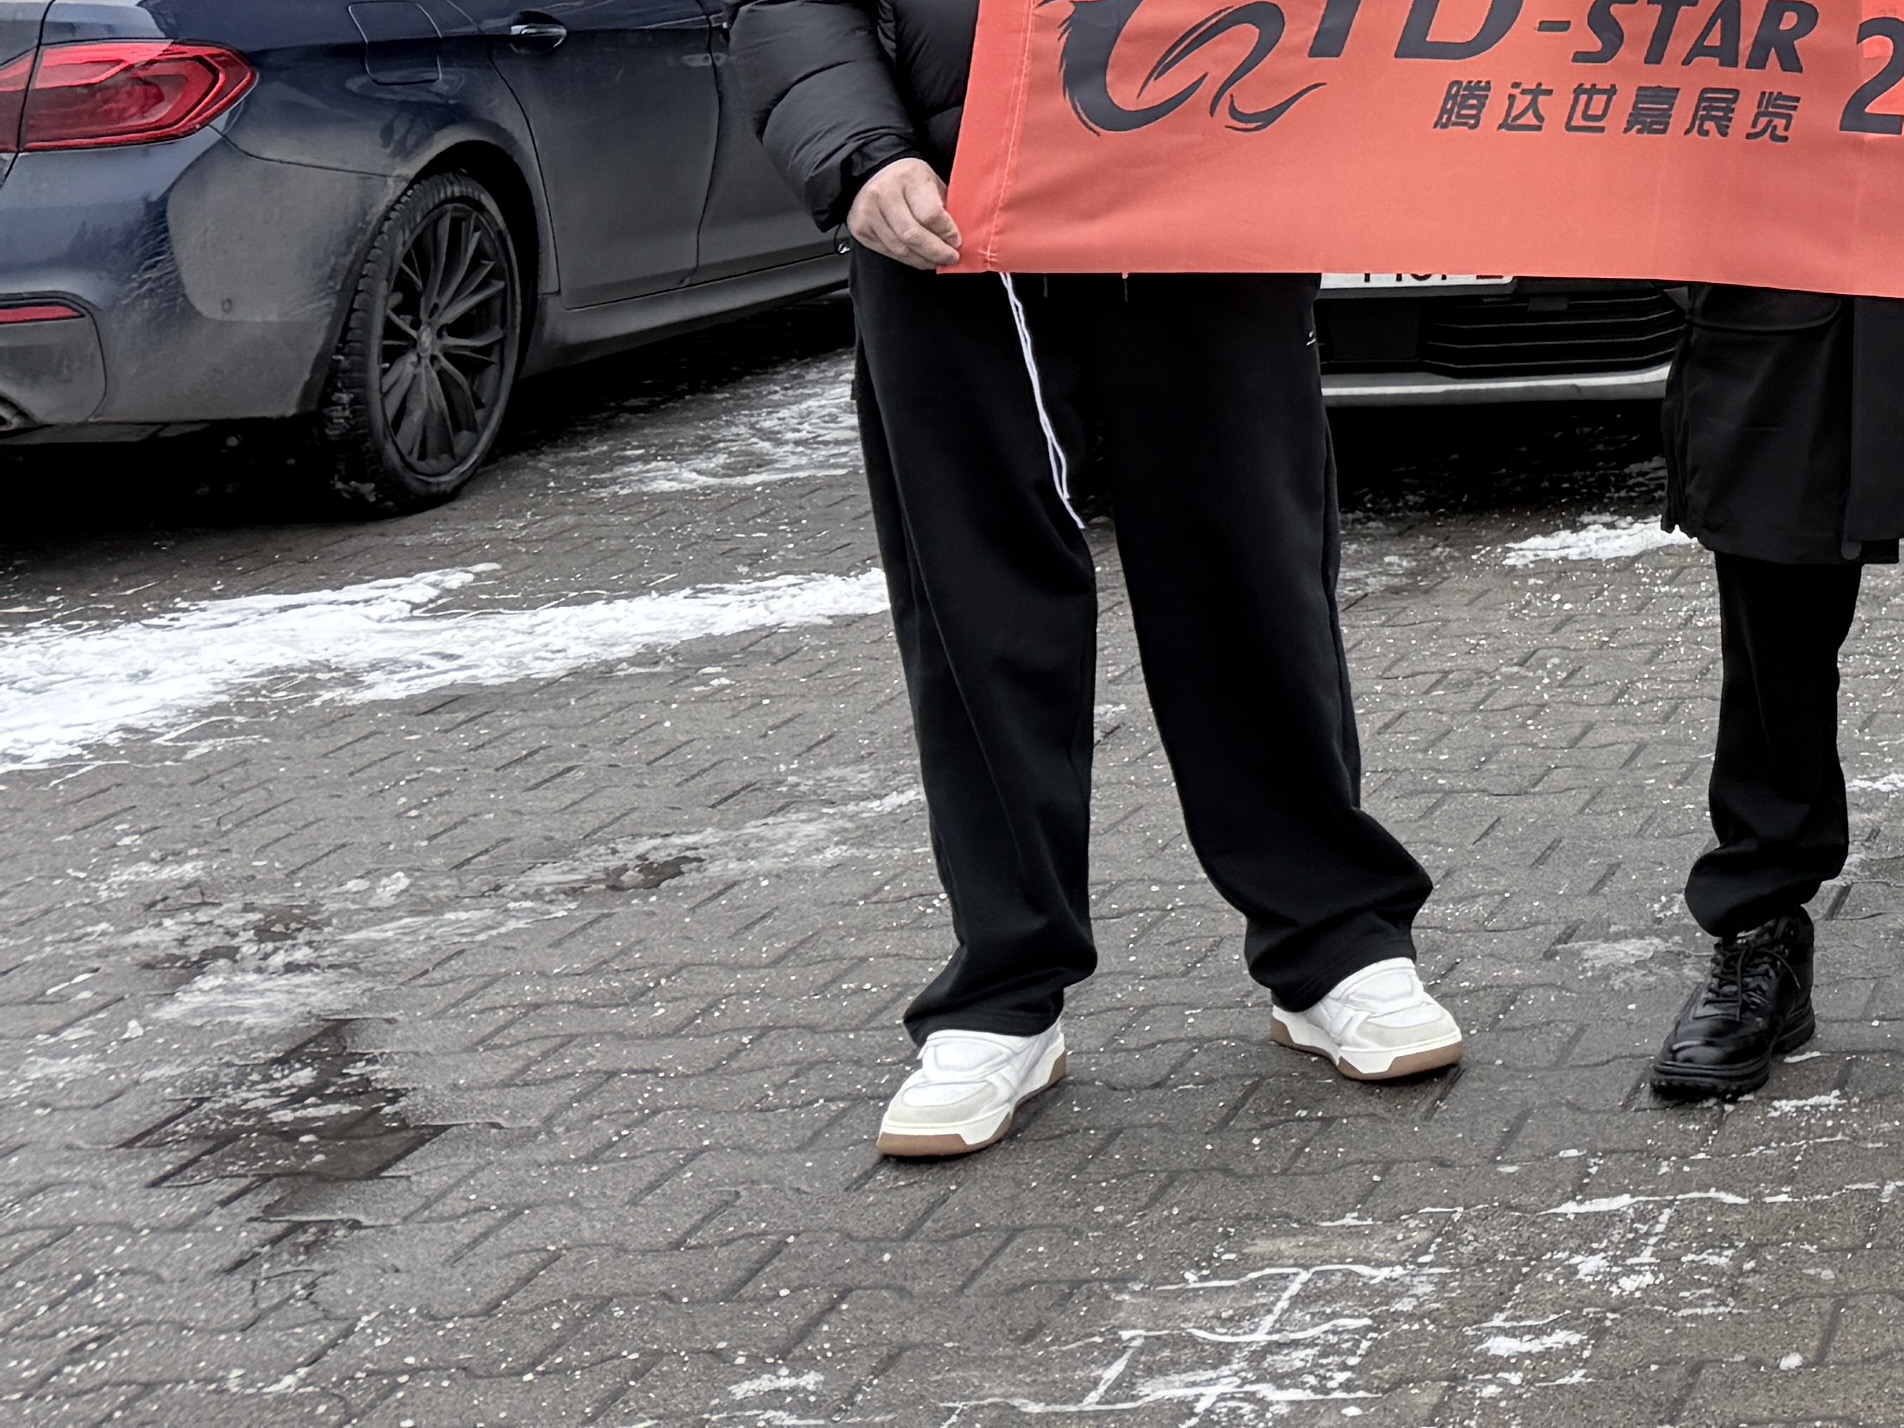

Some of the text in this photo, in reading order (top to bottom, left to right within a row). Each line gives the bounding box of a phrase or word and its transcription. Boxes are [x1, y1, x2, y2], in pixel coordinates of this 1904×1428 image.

[1433, 80, 1801, 143] 腾达世嘉展览
